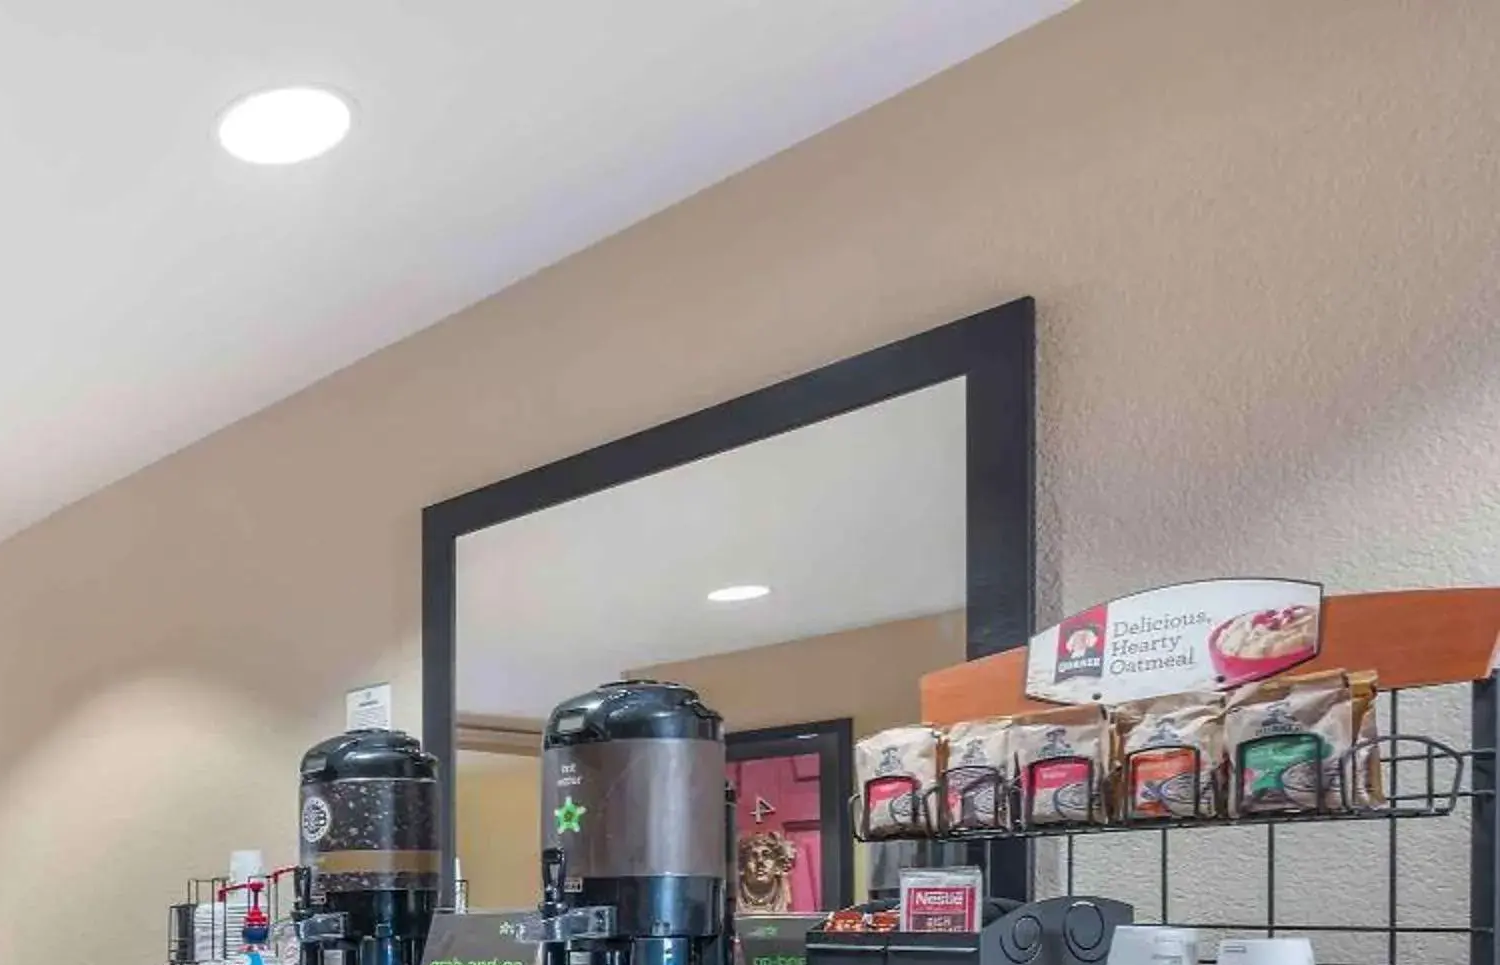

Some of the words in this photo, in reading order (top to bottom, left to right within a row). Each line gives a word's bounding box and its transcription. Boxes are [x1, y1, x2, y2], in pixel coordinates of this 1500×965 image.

[1113, 610, 1211, 637] Delicious,
[1111, 635, 1182, 657] Hearty
[1109, 646, 1198, 675] Oatmeal
